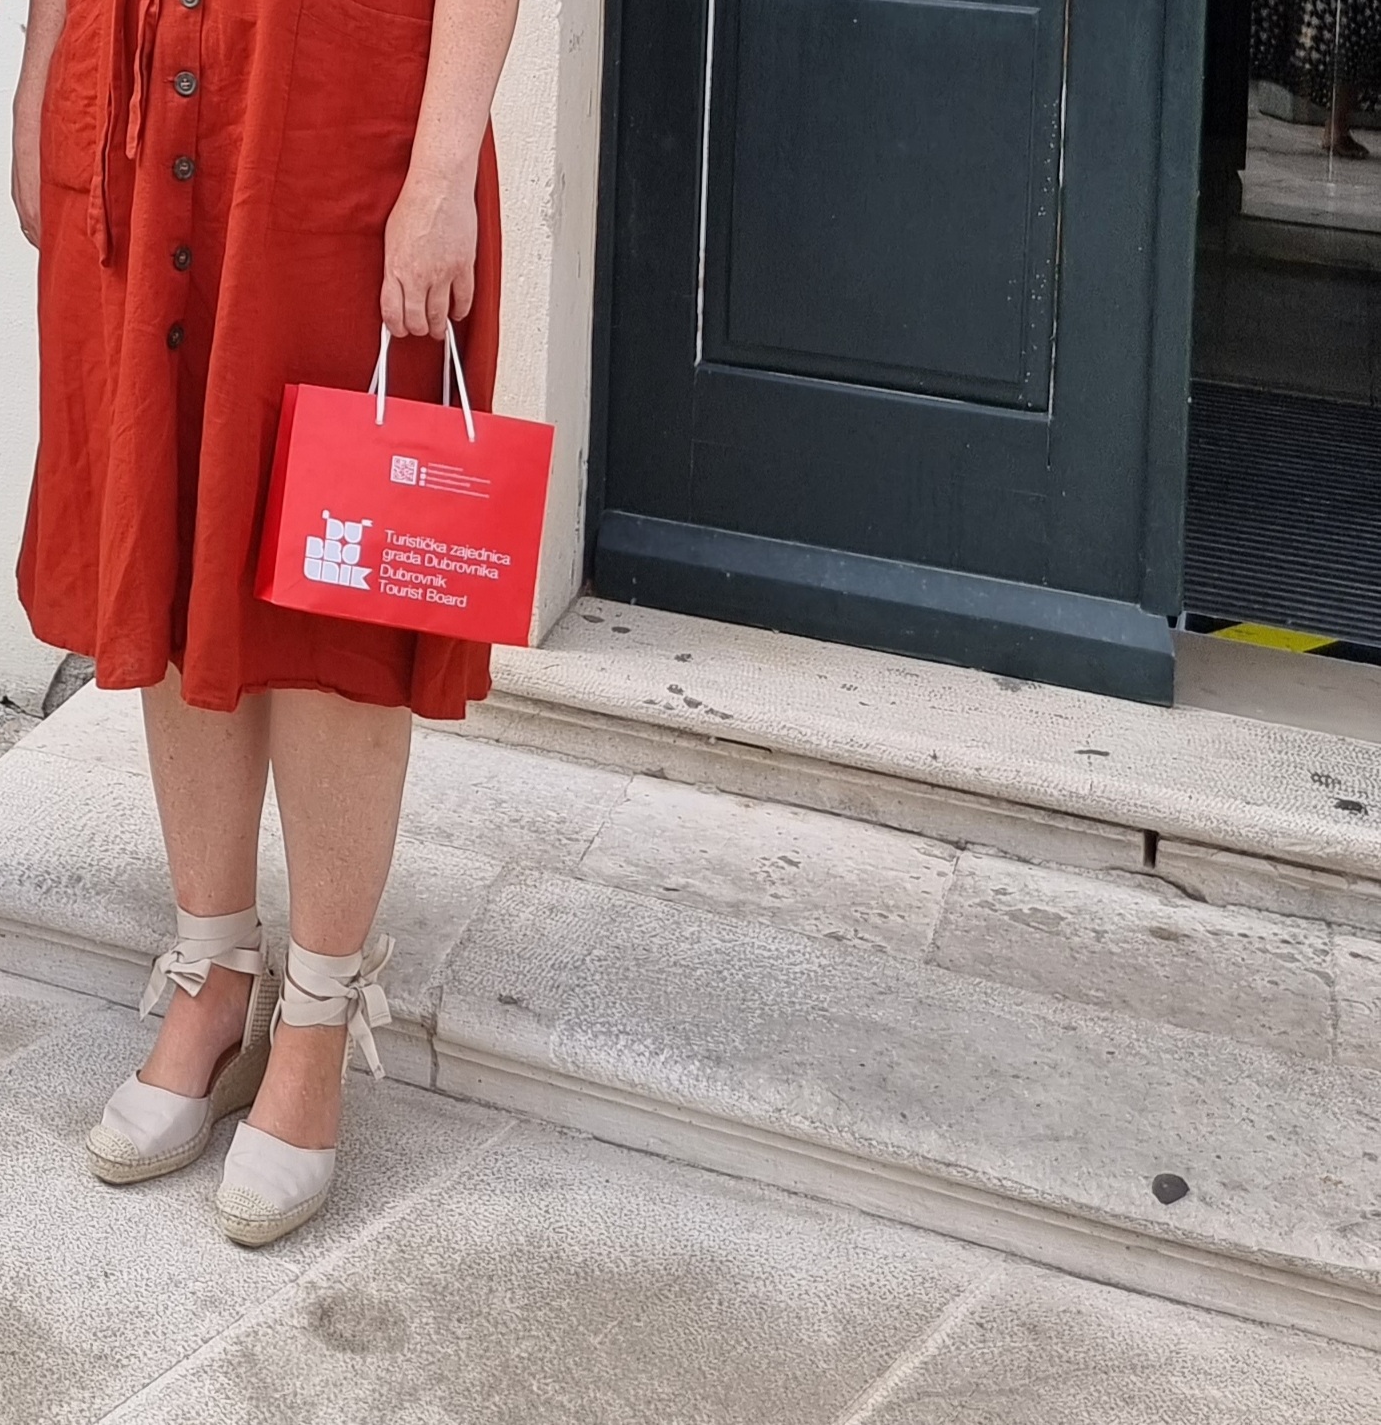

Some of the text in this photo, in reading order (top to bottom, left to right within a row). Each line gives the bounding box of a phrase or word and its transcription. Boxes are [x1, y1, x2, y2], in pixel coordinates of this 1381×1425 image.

[384, 529, 511, 567] Turistička zajednica
[380, 564, 447, 588] Dubrovnik
[382, 547, 499, 580] grada Dubrovnika
[379, 580, 467, 608] Tourist Board
